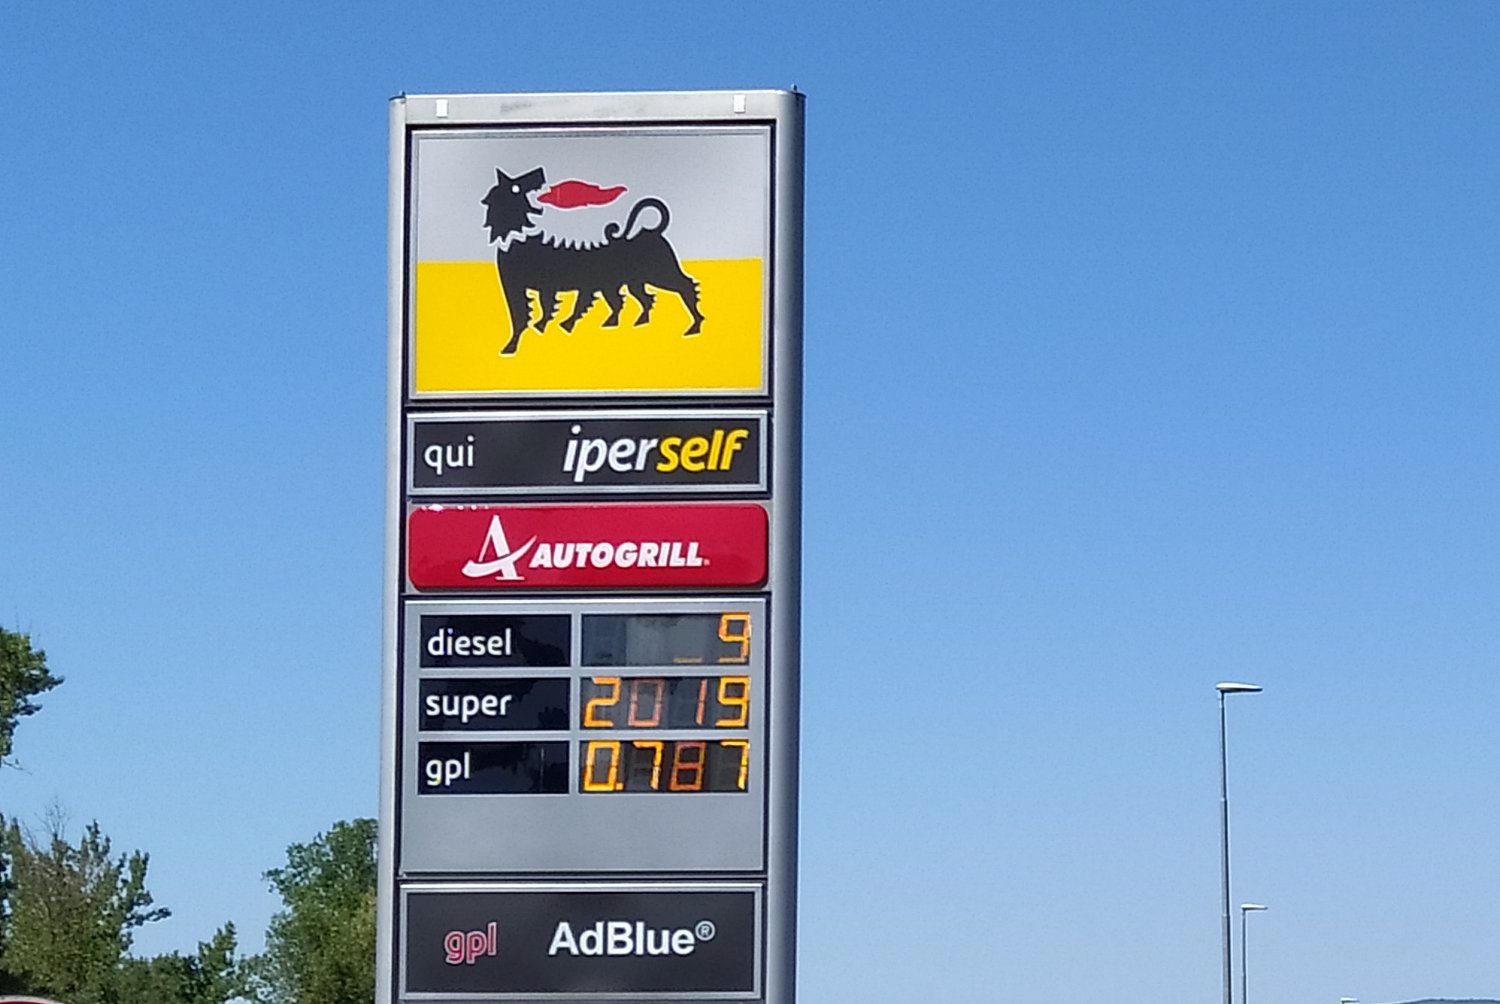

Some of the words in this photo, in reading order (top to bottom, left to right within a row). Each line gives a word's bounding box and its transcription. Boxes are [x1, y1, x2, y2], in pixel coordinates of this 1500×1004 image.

[424, 436, 474, 474] qui
[563, 425, 749, 482] iperself
[528, 541, 704, 568] AUTOGRILL
[427, 628, 512, 656] diesel
[426, 692, 512, 722] super
[425, 752, 471, 786] gpl
[444, 922, 497, 964] gpl
